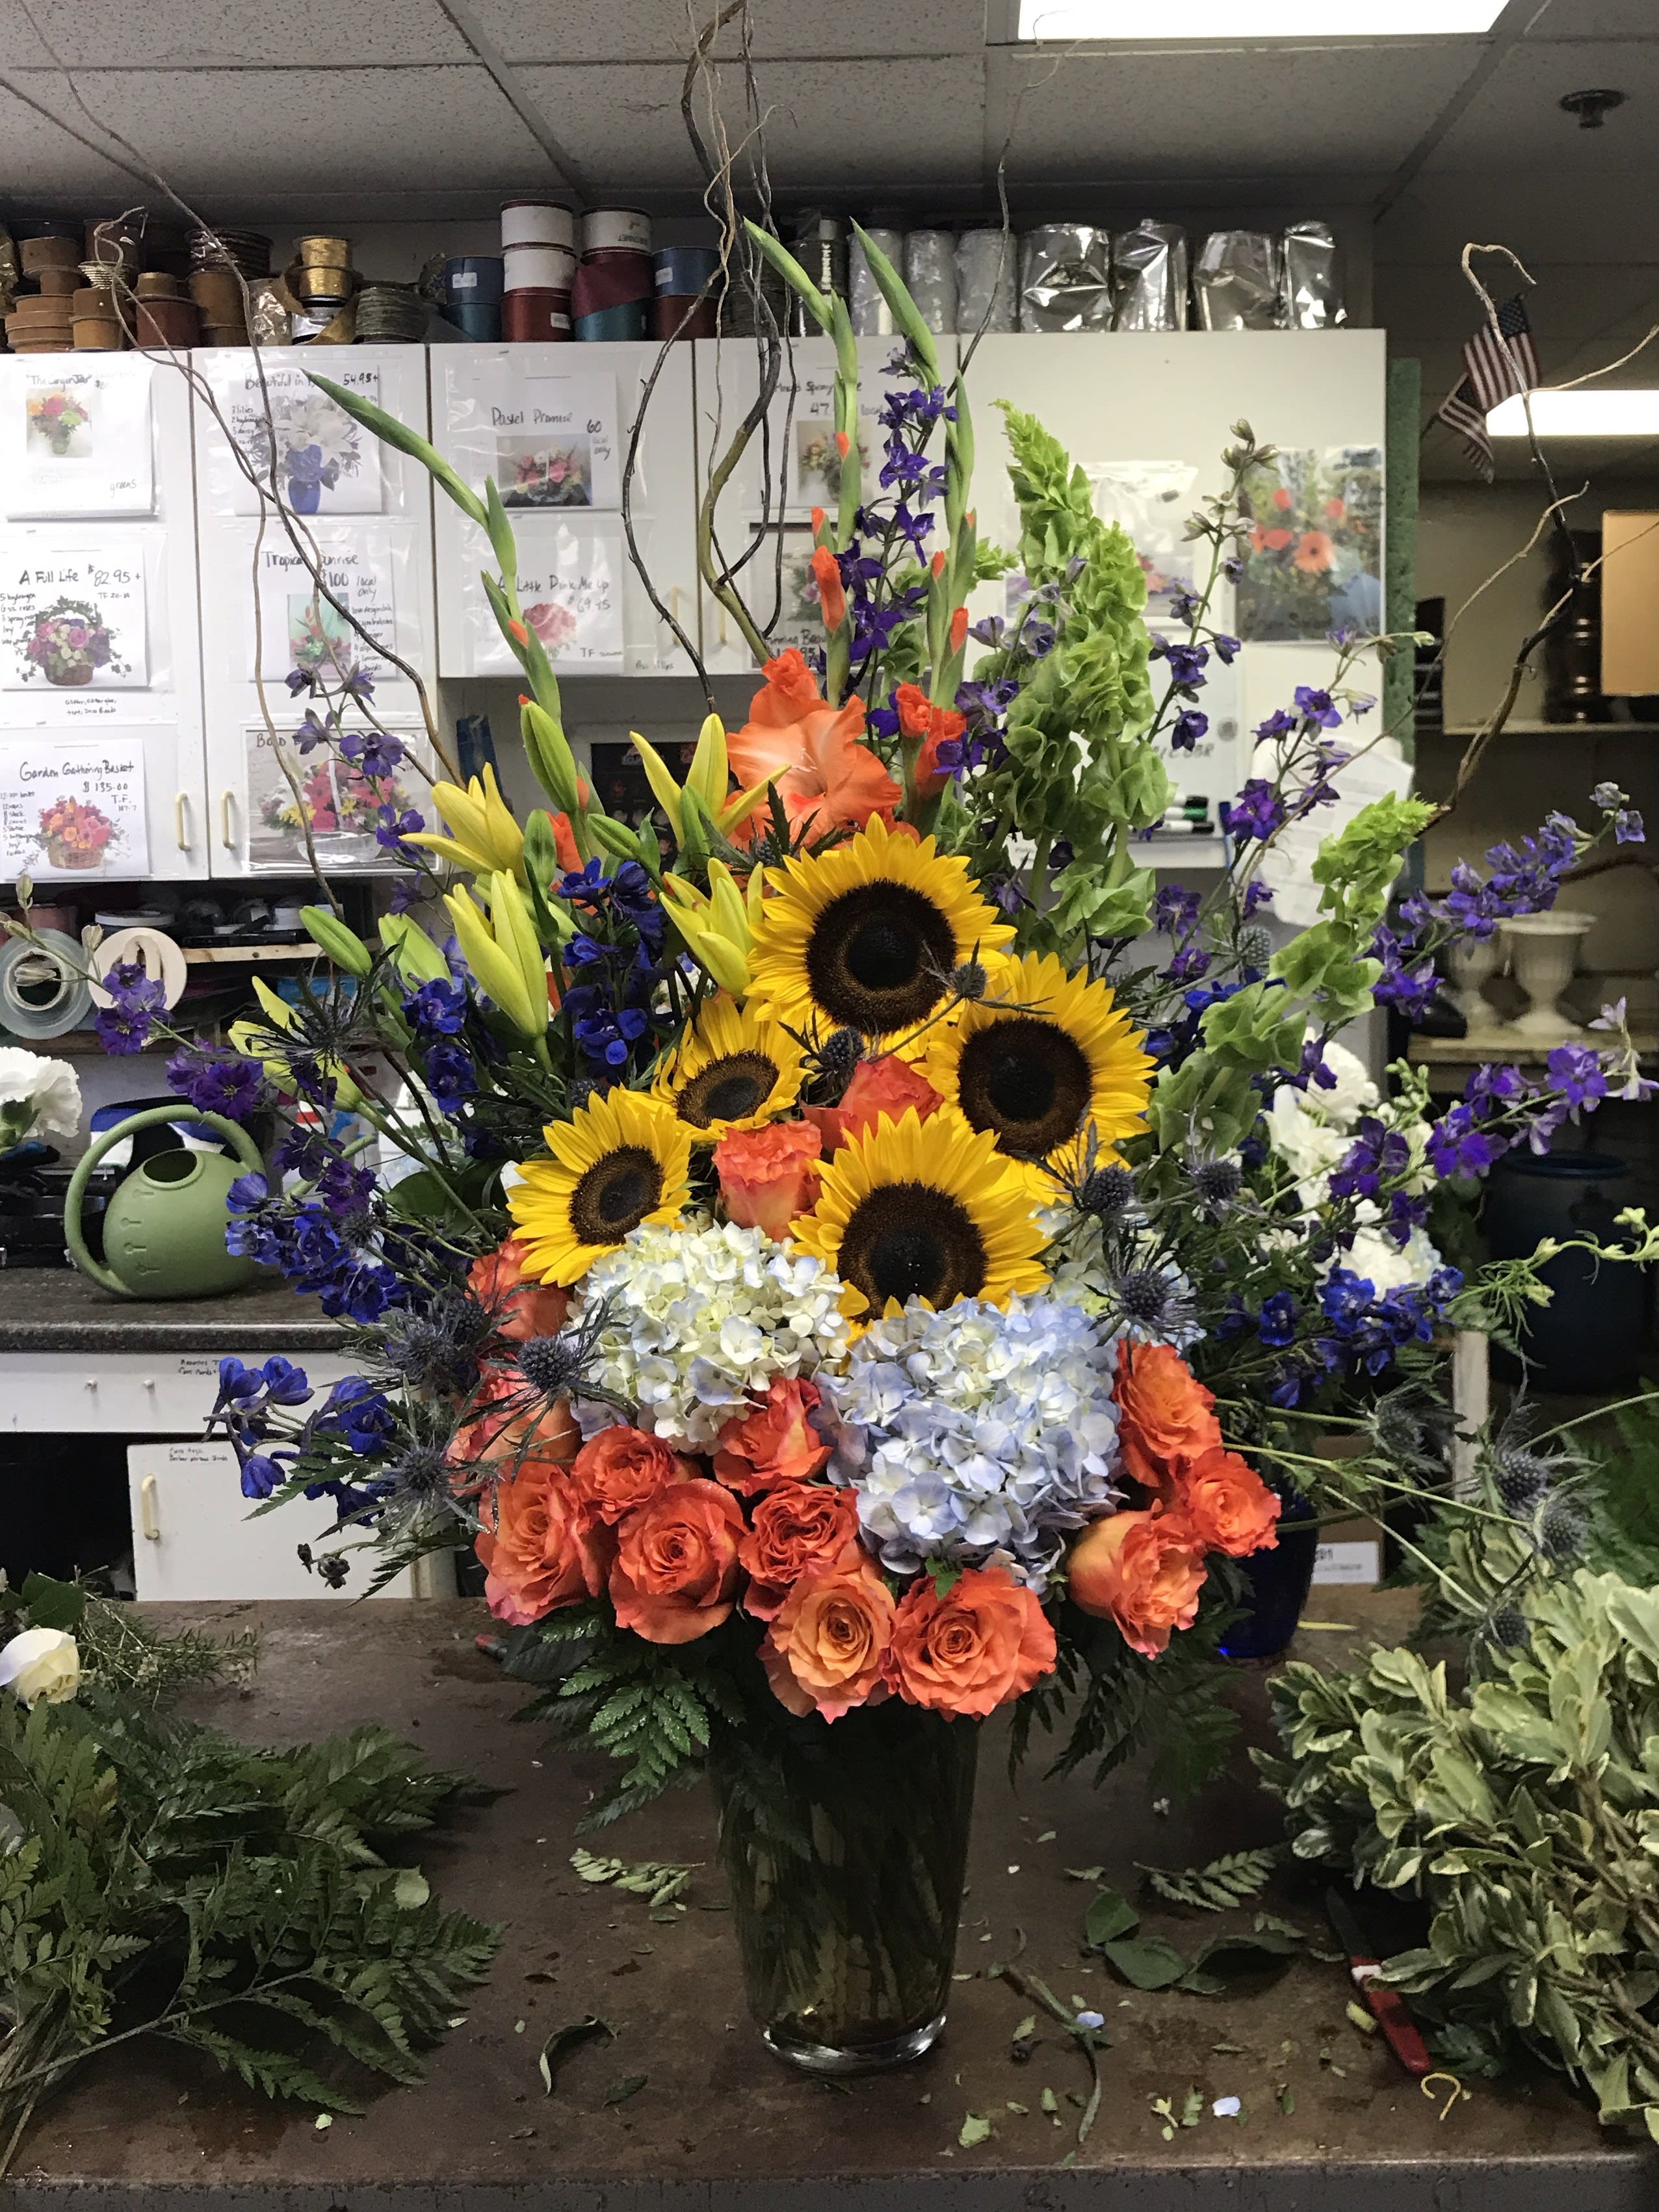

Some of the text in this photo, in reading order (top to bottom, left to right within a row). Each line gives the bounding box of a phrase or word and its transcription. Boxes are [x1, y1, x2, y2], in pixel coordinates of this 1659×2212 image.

[245, 373, 293, 390] Beutiful
[261, 551, 304, 573] Tropica
[20, 569, 31, 585] A
[35, 571, 54, 584] Full
[20, 759, 135, 782] Garden Gathering Basket
